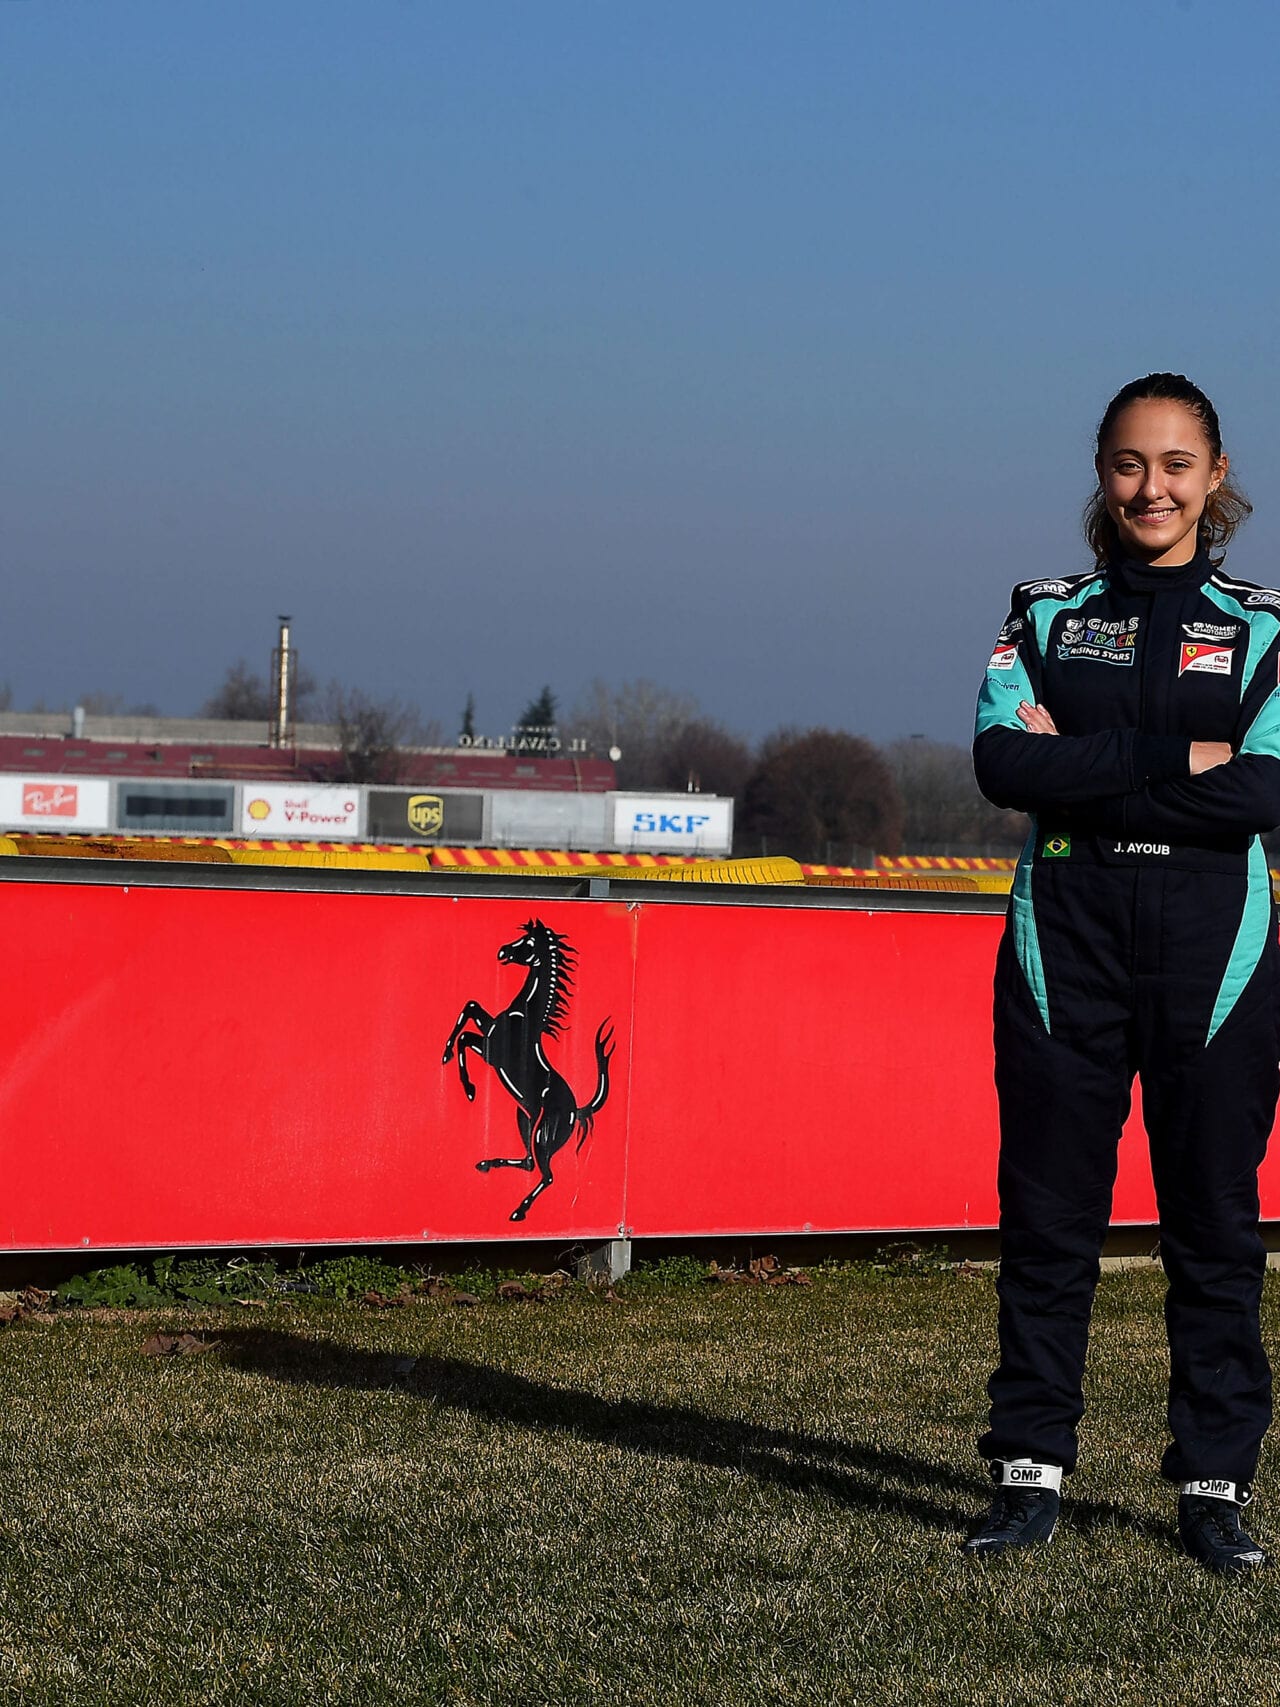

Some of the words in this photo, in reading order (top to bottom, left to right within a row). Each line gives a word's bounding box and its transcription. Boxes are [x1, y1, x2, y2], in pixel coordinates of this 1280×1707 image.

[1087, 617, 1140, 635] GIRLS
[1205, 623, 1236, 632] WOMEN
[1061, 630, 1085, 645] ON
[1086, 630, 1136, 648] TRACK
[1070, 646, 1100, 656] RISING
[1101, 650, 1131, 661] STARS
[285, 800, 308, 808] Shell
[410, 807, 440, 829] ups
[633, 813, 710, 833] SKF
[1113, 842, 1124, 853] J.
[1126, 842, 1170, 855] AYOUB
[1010, 1469, 1042, 1481] OMP
[1199, 1480, 1230, 1493] OMP
